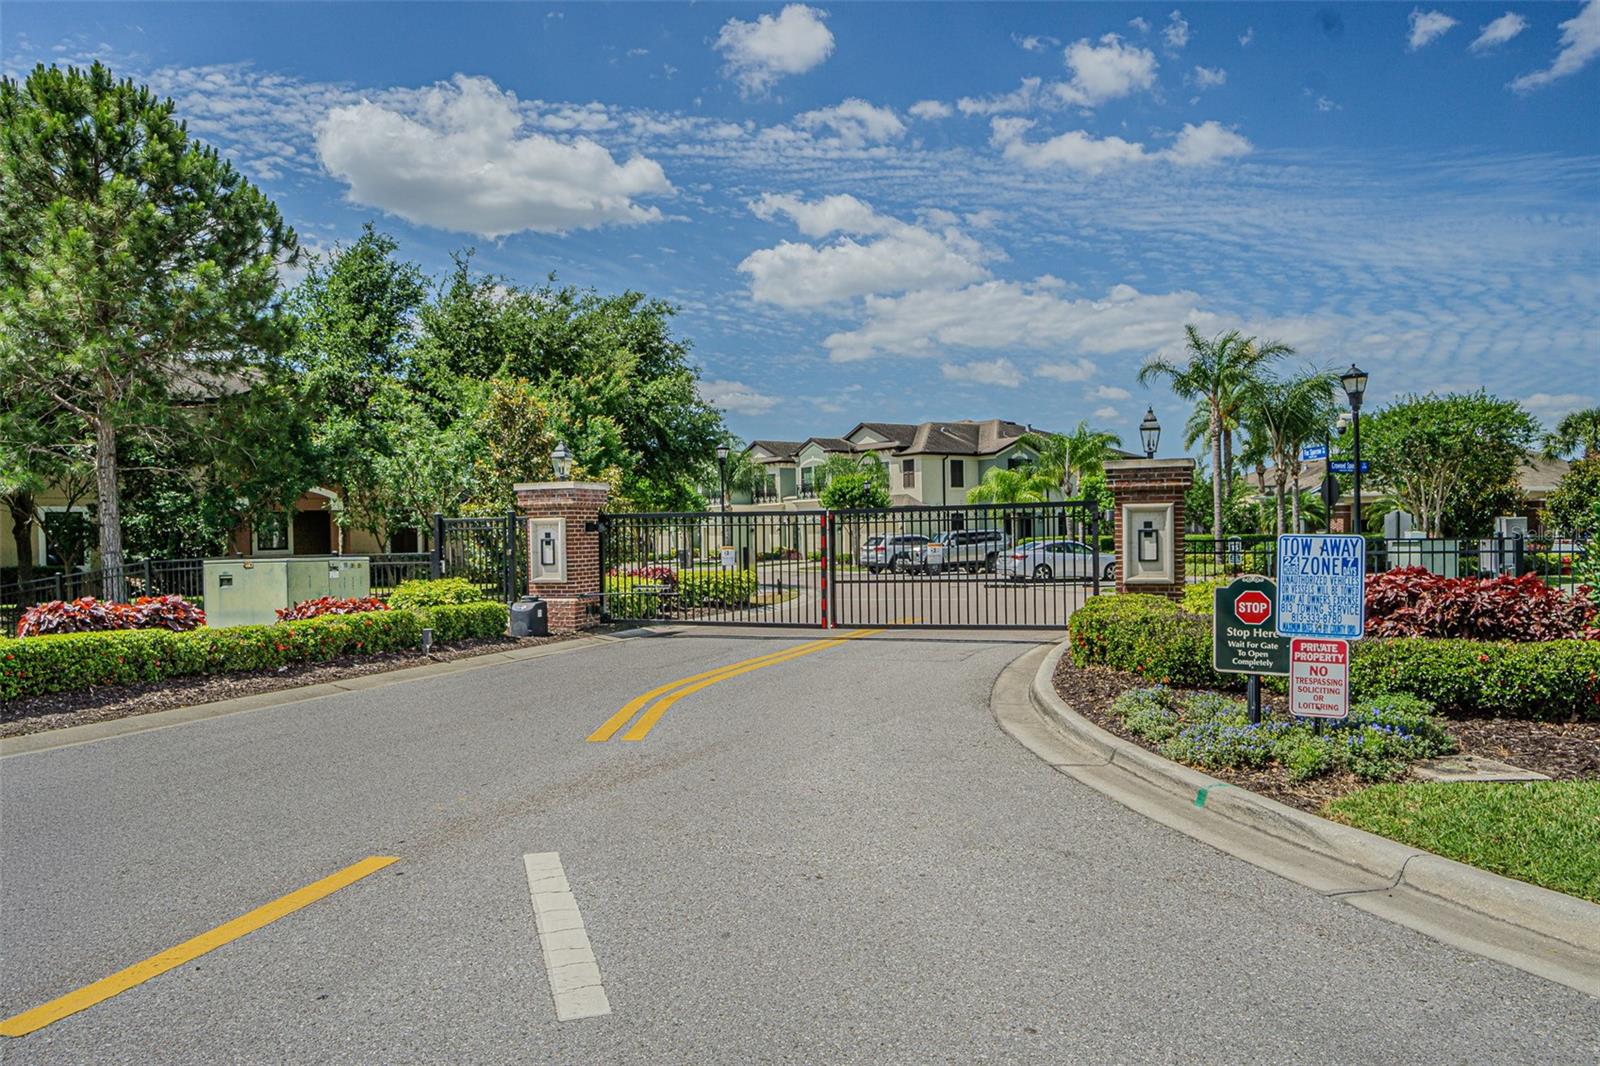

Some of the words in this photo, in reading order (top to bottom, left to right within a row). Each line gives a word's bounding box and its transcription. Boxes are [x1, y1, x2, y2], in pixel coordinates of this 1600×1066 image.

[1283, 538, 1312, 556] TOW
[1320, 539, 1359, 556] AWAY
[1283, 556, 1299, 566] 24
[1301, 557, 1340, 575] ZONE
[1282, 576, 1327, 585] UNAUTHORIZED
[1330, 576, 1359, 585] VEHICLES
[1282, 585, 1289, 594] OR
[1292, 585, 1314, 594] VESSELS
[1331, 586, 1338, 595] BE
[1282, 595, 1296, 603] AWAY
[1299, 595, 1304, 604] AT
[1333, 596, 1359, 605] EXPENSE
[1238, 602, 1268, 613] STOP
[1281, 603, 1292, 612] 813
[1297, 604, 1323, 614] TOWING
[1329, 605, 1359, 615] SERVICE
[1292, 613, 1342, 624] 813-333-8780
[1227, 627, 1250, 639] Stop
[1253, 628, 1279, 638] Here
[1300, 642, 1338, 653] PRIVATE
[1248, 650, 1268, 659] Open
[1294, 652, 1344, 662] PROPERTY
[1232, 658, 1273, 668] Completely
[1310, 666, 1328, 676] NO
[1296, 677, 1343, 686] TRESPASSING
[1298, 686, 1340, 694] SOLICITING
[1298, 702, 1339, 711] LOITERING
